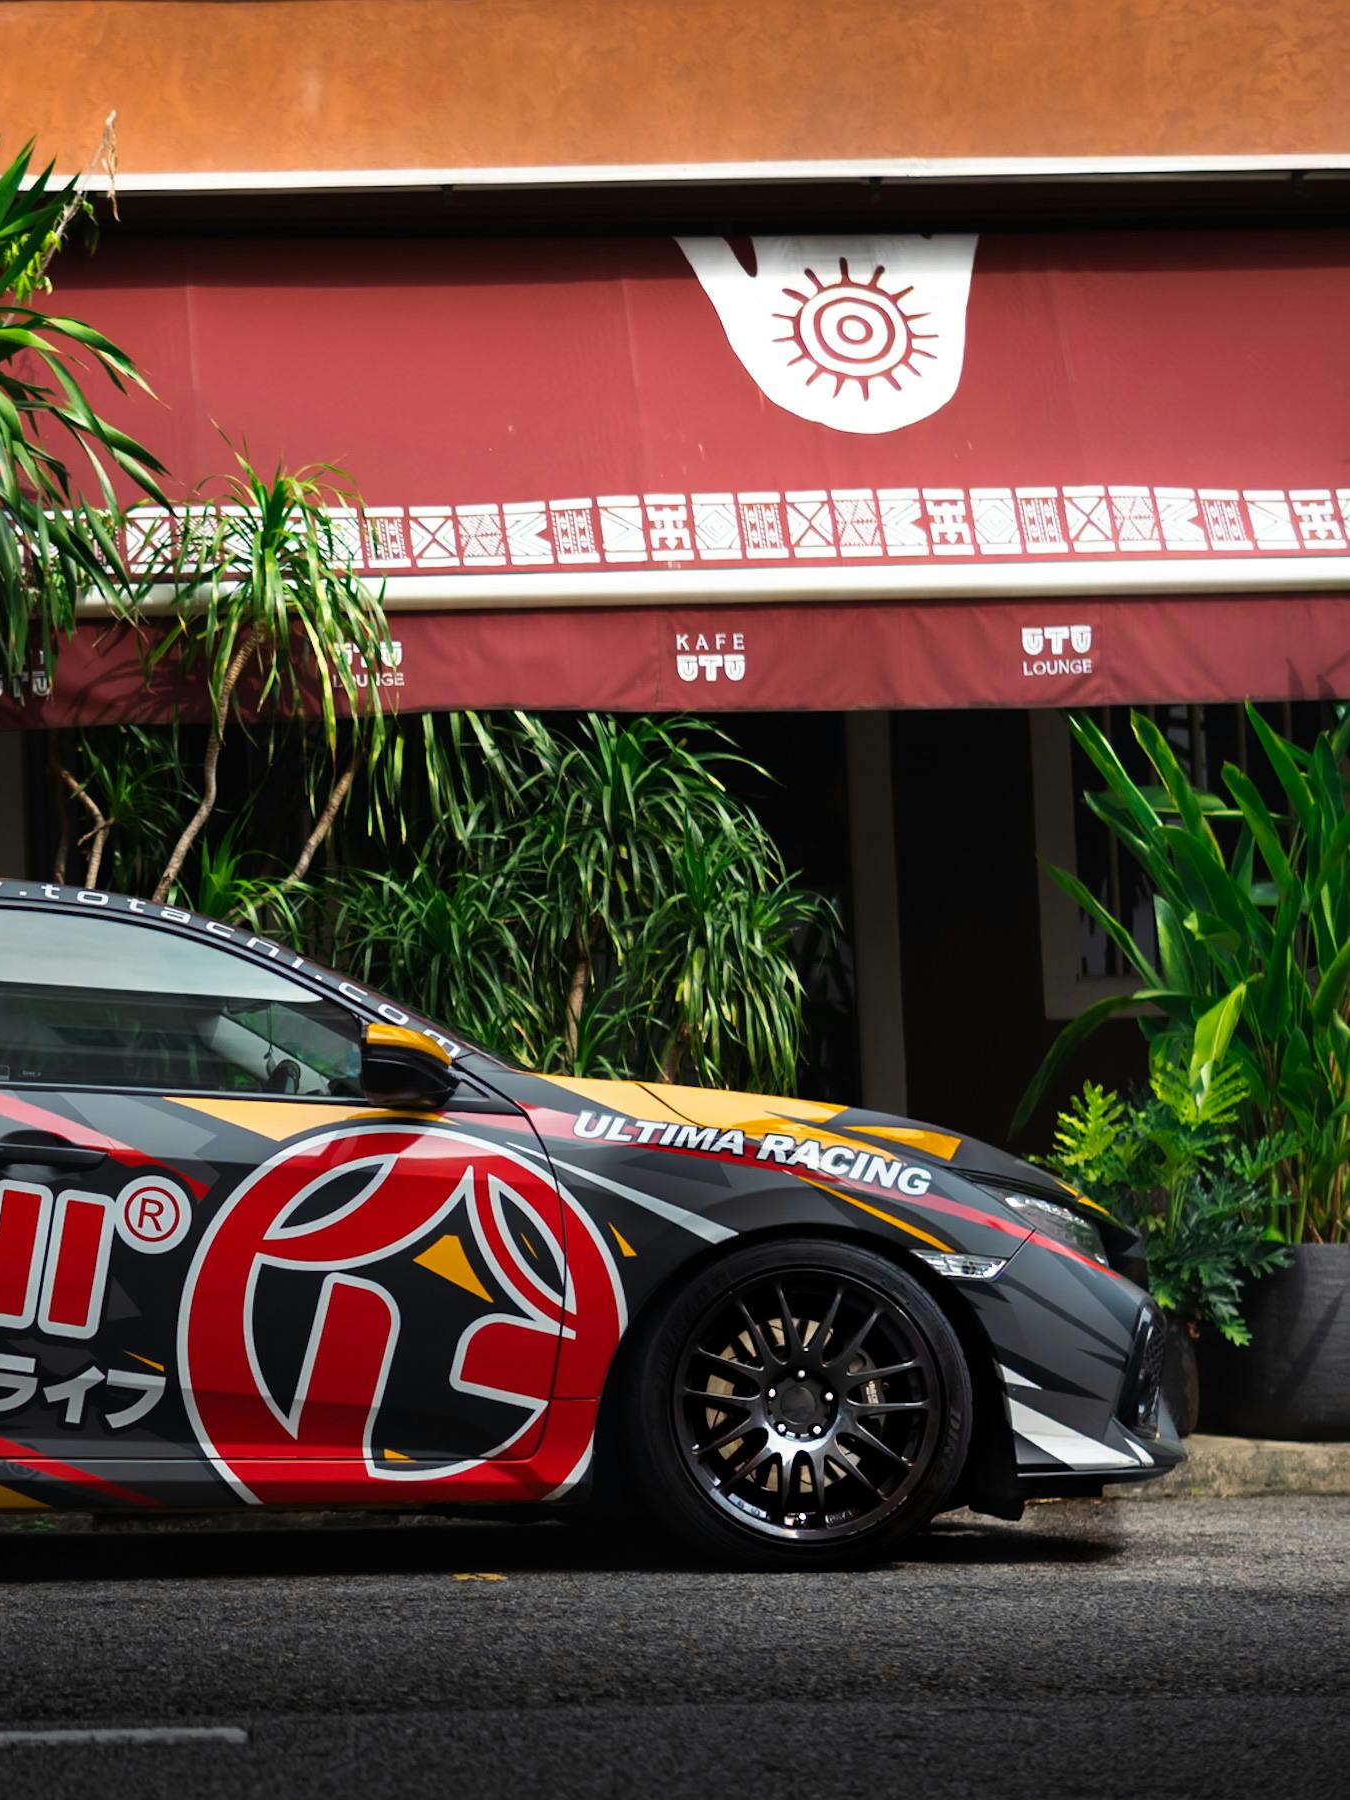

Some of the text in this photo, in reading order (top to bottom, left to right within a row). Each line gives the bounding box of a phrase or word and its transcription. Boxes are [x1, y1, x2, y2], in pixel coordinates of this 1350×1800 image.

[676, 634, 746, 650] KAFE
[1022, 660, 1093, 675] LOUNGE
[333, 672, 405, 688] LUGE
[571, 1110, 933, 1197] ULTIMA RACING
